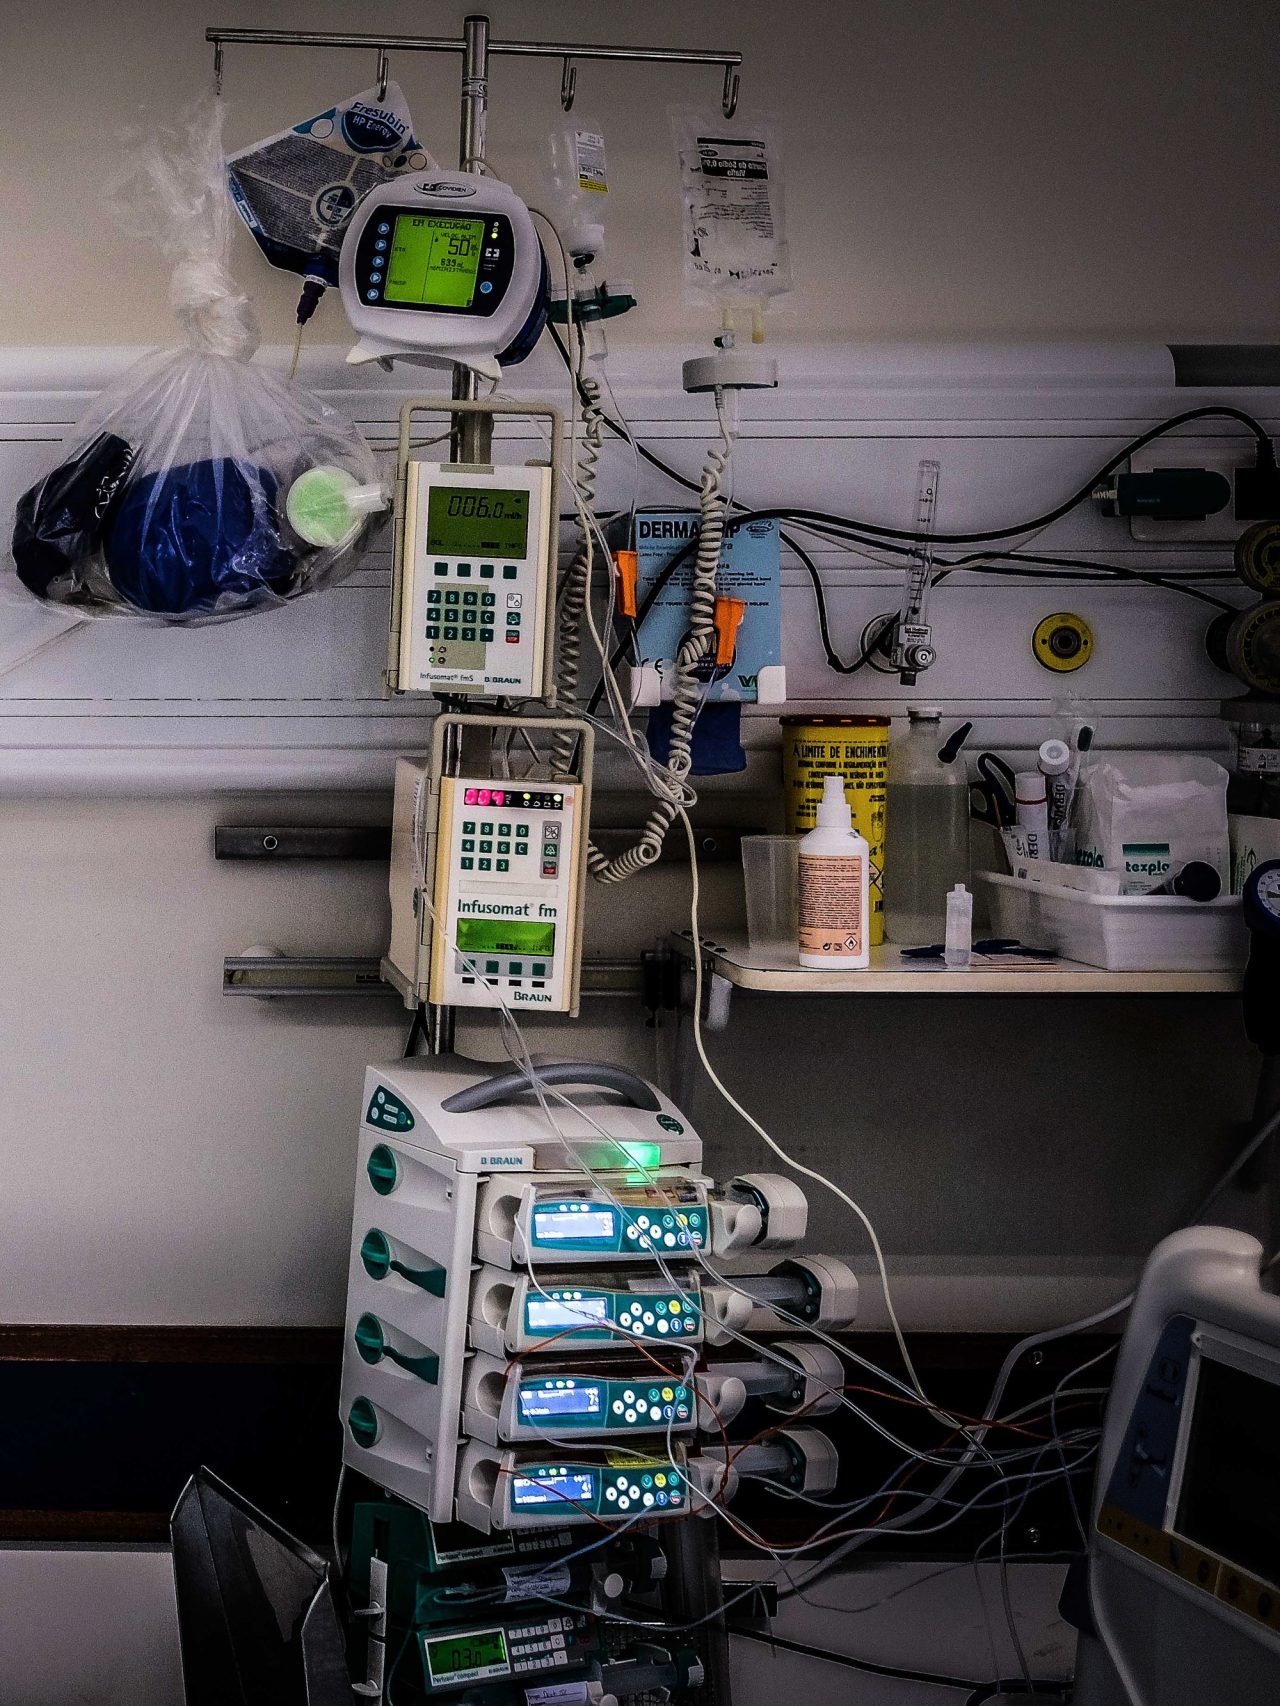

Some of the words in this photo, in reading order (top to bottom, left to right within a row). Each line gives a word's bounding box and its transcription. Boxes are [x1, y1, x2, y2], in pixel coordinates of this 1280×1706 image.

[351, 101, 407, 135] Fresubin
[352, 114, 365, 125] HP
[369, 120, 392, 139] Energy
[447, 238, 471, 257] 50
[440, 258, 457, 267] 639
[447, 495, 504, 519] 006.0
[431, 593, 437, 601] 7
[449, 594, 456, 602] 8
[467, 595, 474, 603] 9
[485, 596, 492, 604] 0
[448, 612, 455, 620] 5
[484, 613, 491, 621] C
[466, 630, 472, 638] 3
[460, 674, 474, 682] fmS
[801, 745, 826, 758] LIMITE
[829, 746, 841, 758] DE
[484, 825, 490, 833] 8
[501, 826, 508, 834] 9
[519, 827, 526, 835] 0
[518, 845, 525, 853] C
[482, 861, 488, 869] 2
[500, 861, 506, 869] 3
[538, 904, 557, 917] fm
[513, 991, 552, 1002] BRAUN
[489, 1157, 523, 1165] BRAUN
